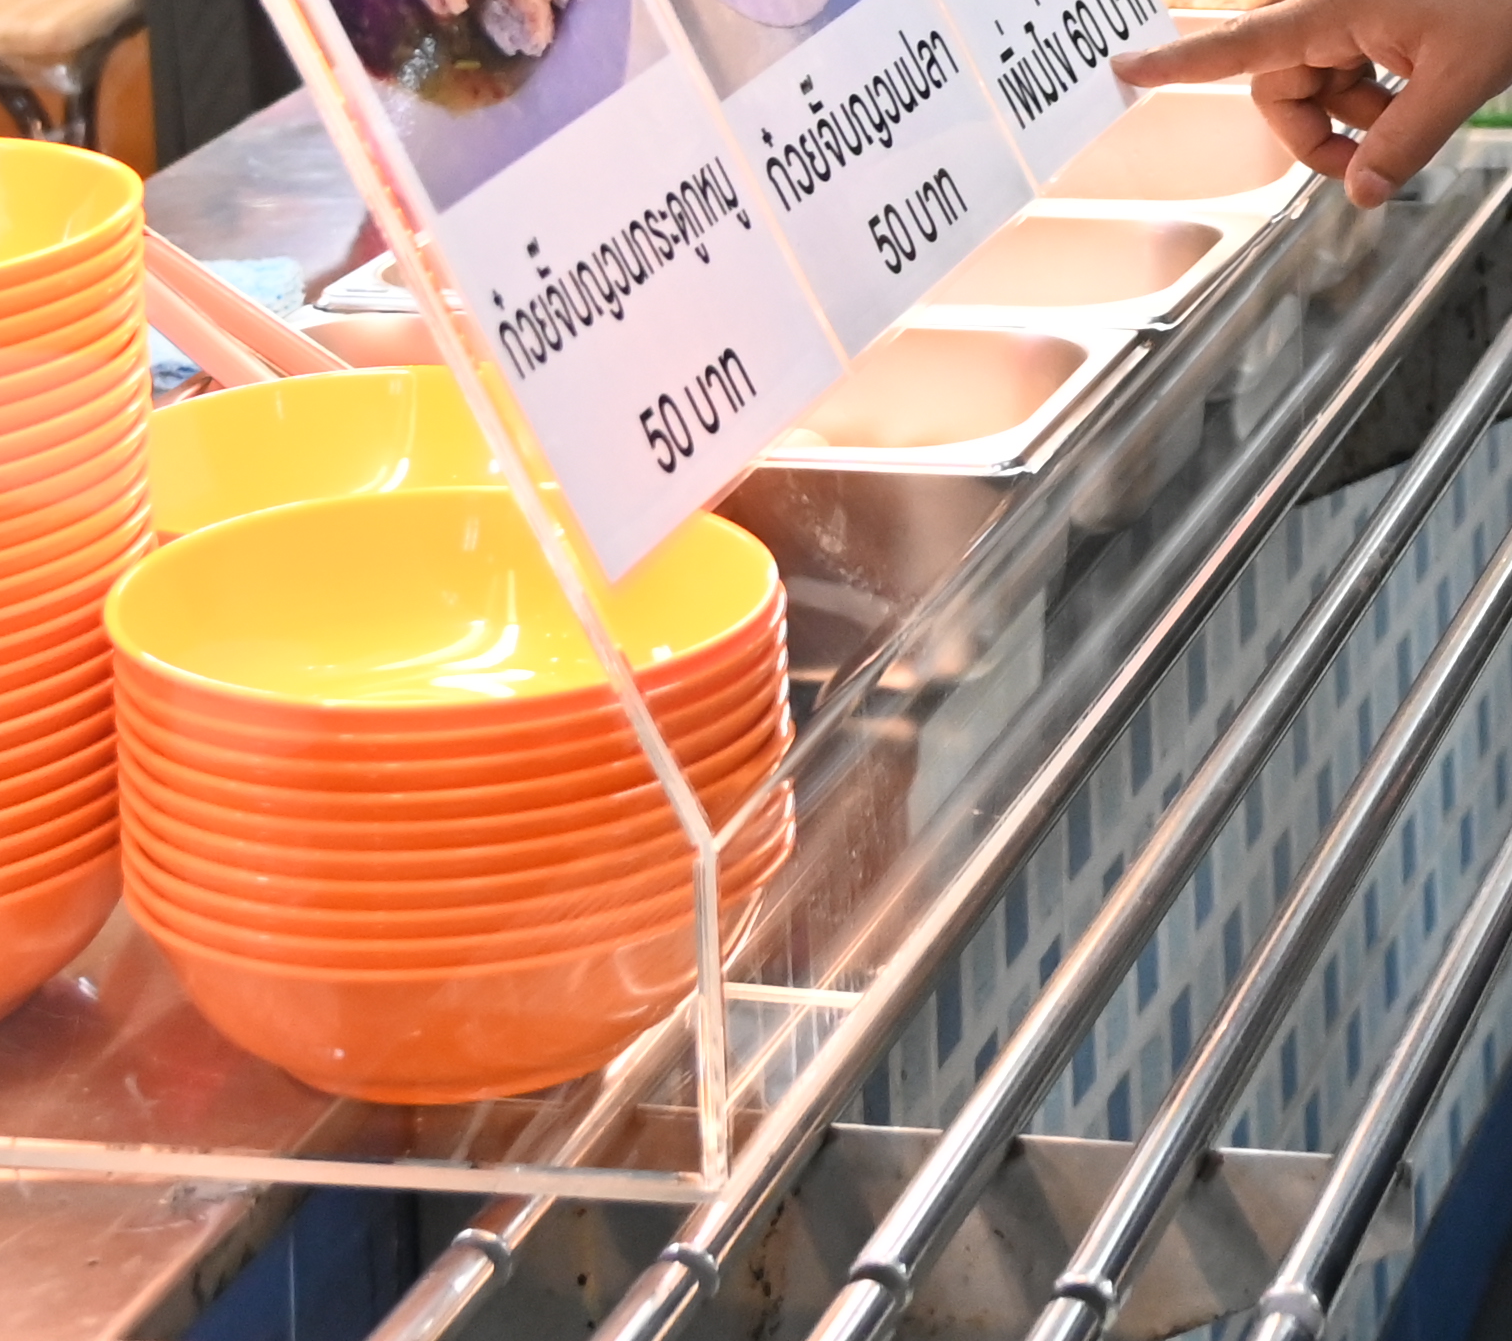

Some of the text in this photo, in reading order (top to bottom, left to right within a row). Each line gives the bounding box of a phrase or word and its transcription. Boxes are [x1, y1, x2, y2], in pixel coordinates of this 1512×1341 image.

[1062, 0, 1109, 68] 60
[761, 29, 960, 212] ก๋วยจั๊บญวนปลา
[868, 168, 968, 275] 50 บาท
[639, 347, 757, 474] 50 บาท
